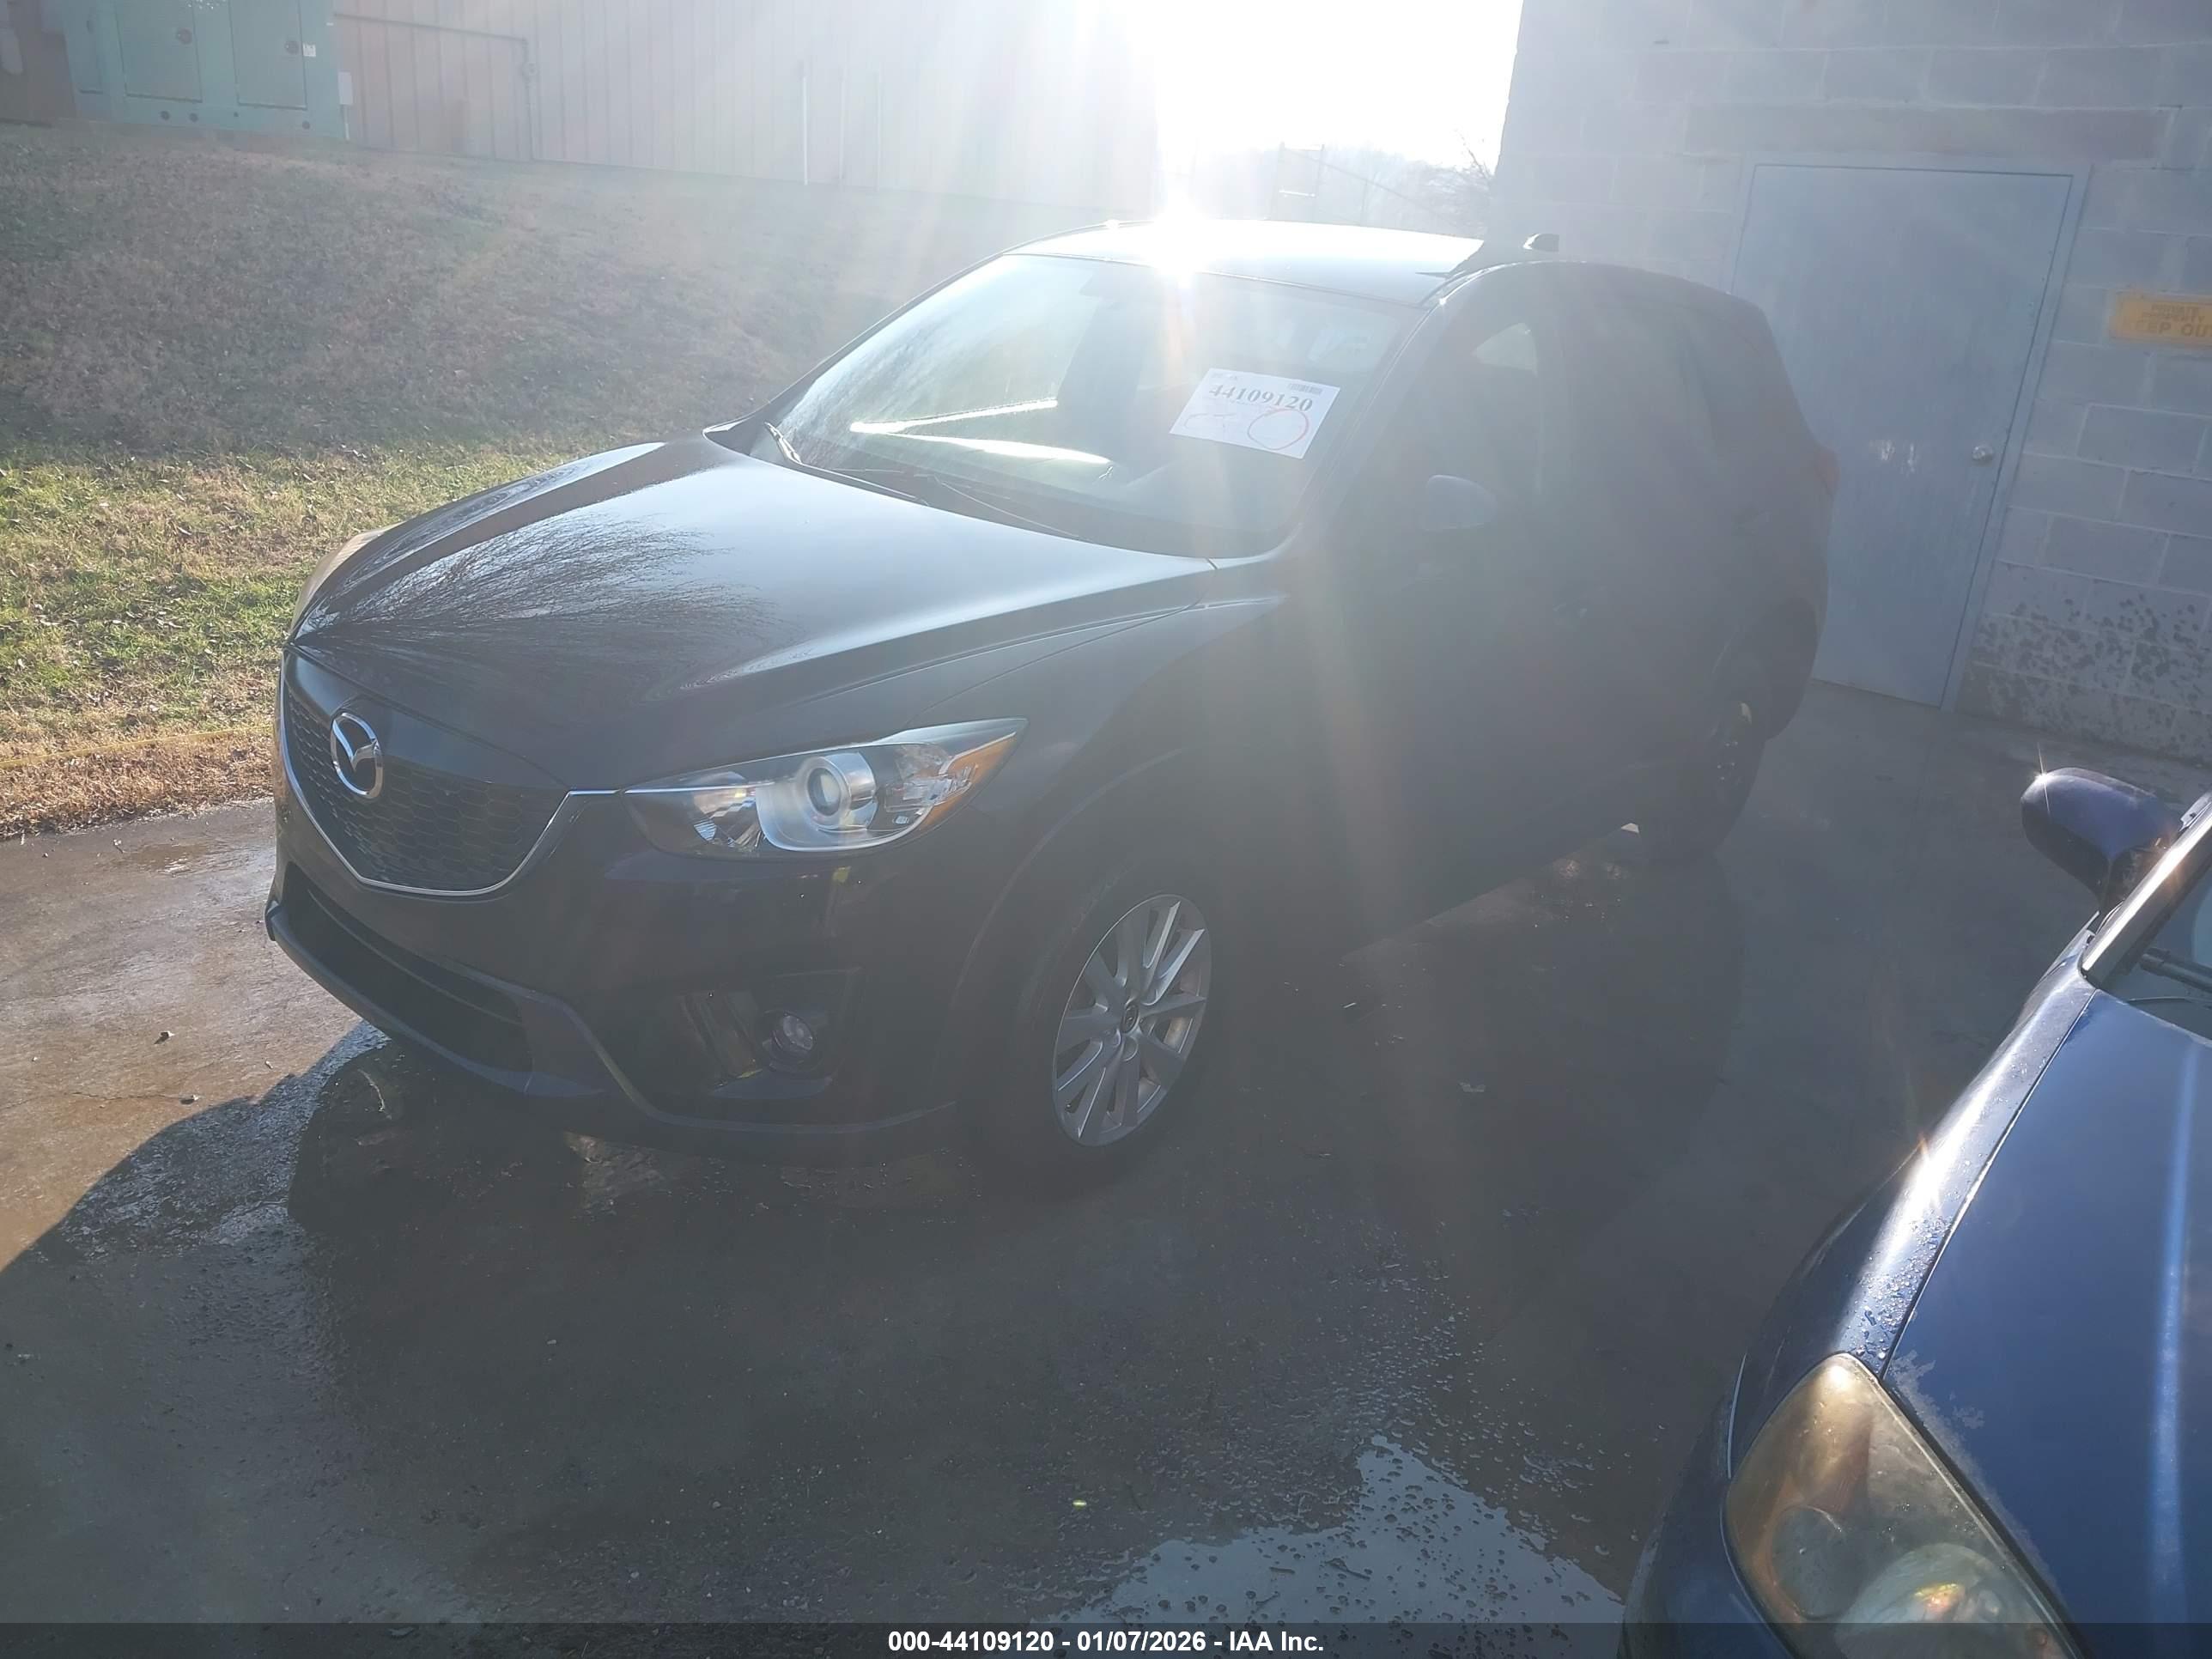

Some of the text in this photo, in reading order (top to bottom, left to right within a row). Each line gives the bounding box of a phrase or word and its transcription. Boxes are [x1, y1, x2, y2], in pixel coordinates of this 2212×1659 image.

[2124, 320, 2212, 337] EEP OU
[1209, 384, 1313, 412] 44109120
